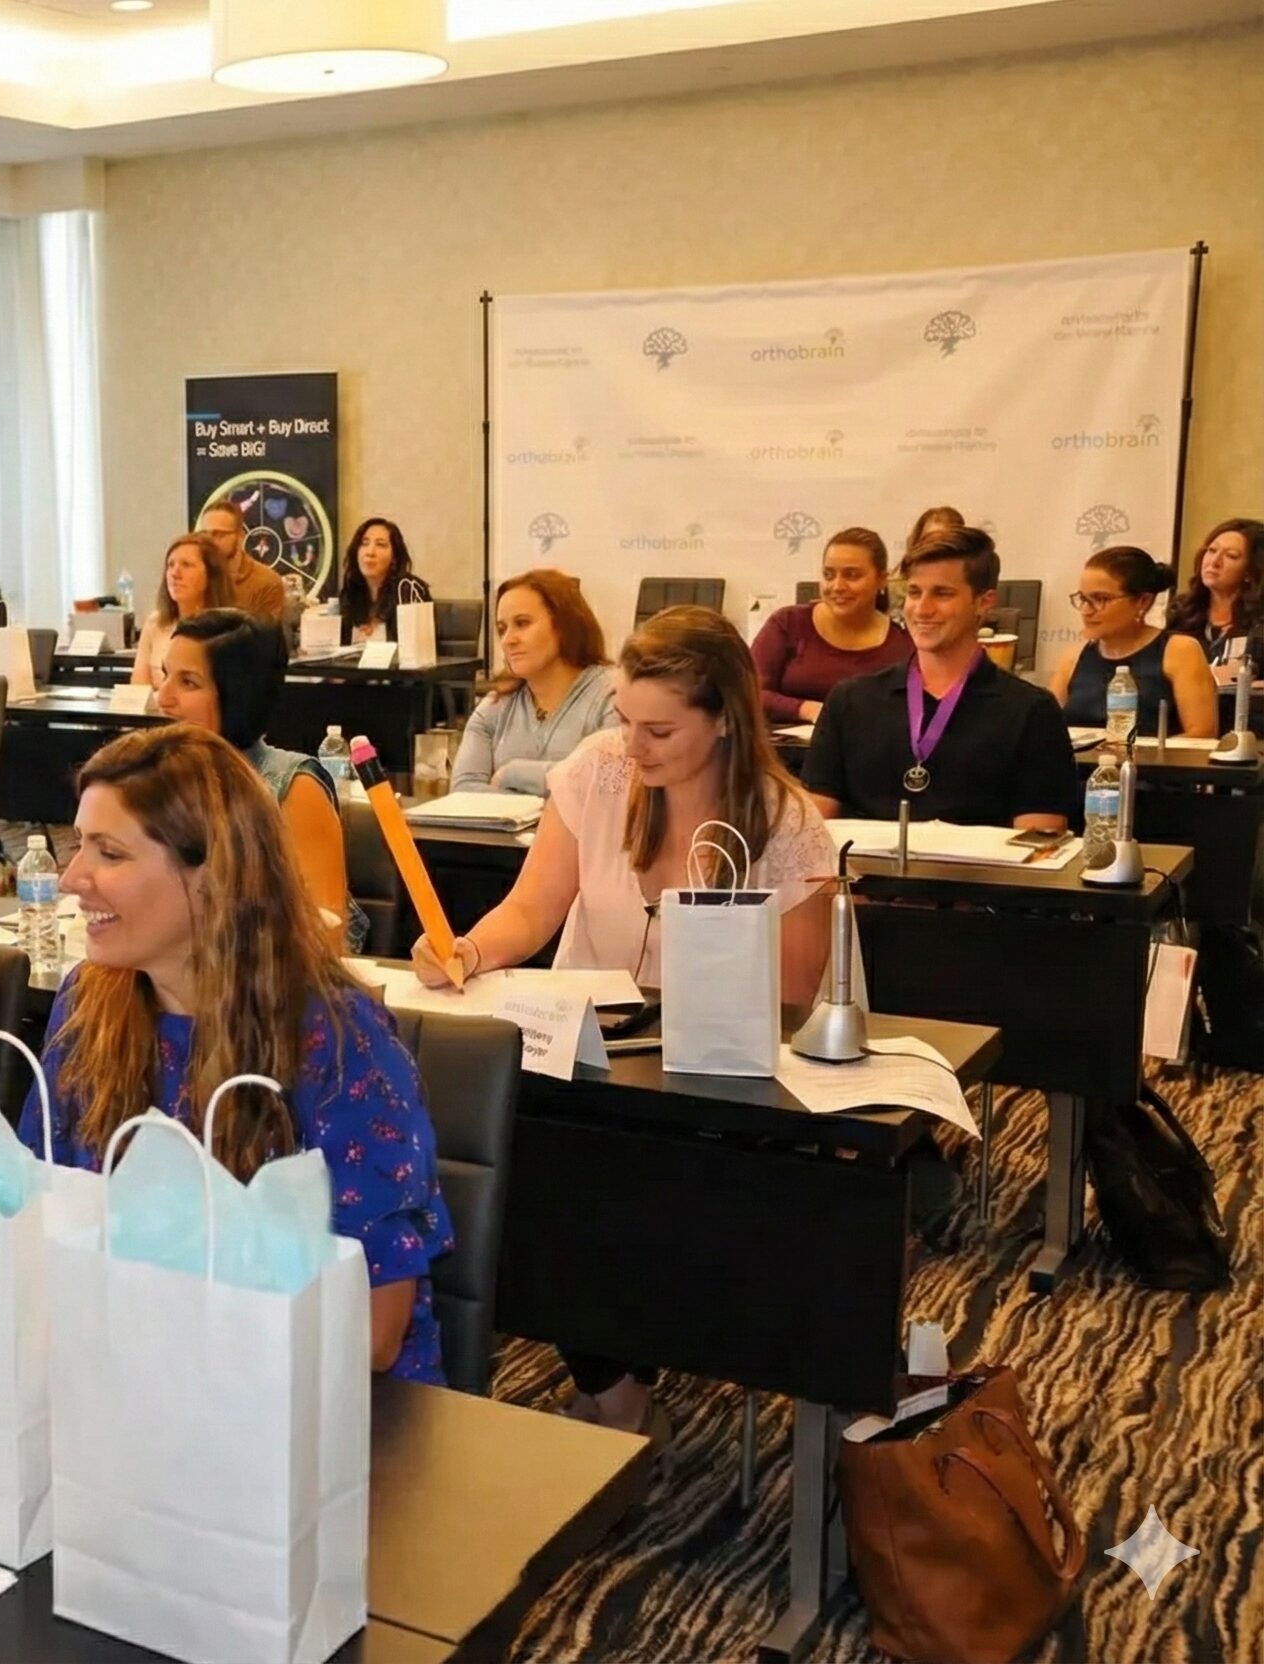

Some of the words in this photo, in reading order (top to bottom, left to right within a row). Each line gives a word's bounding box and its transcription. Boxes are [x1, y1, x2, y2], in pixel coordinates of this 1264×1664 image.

[751, 345, 845, 362] orthobrain
[195, 421, 217, 439] Buy
[219, 420, 255, 436] Smart
[268, 419, 292, 438] Buy
[1052, 431, 1160, 449] orthobrain
